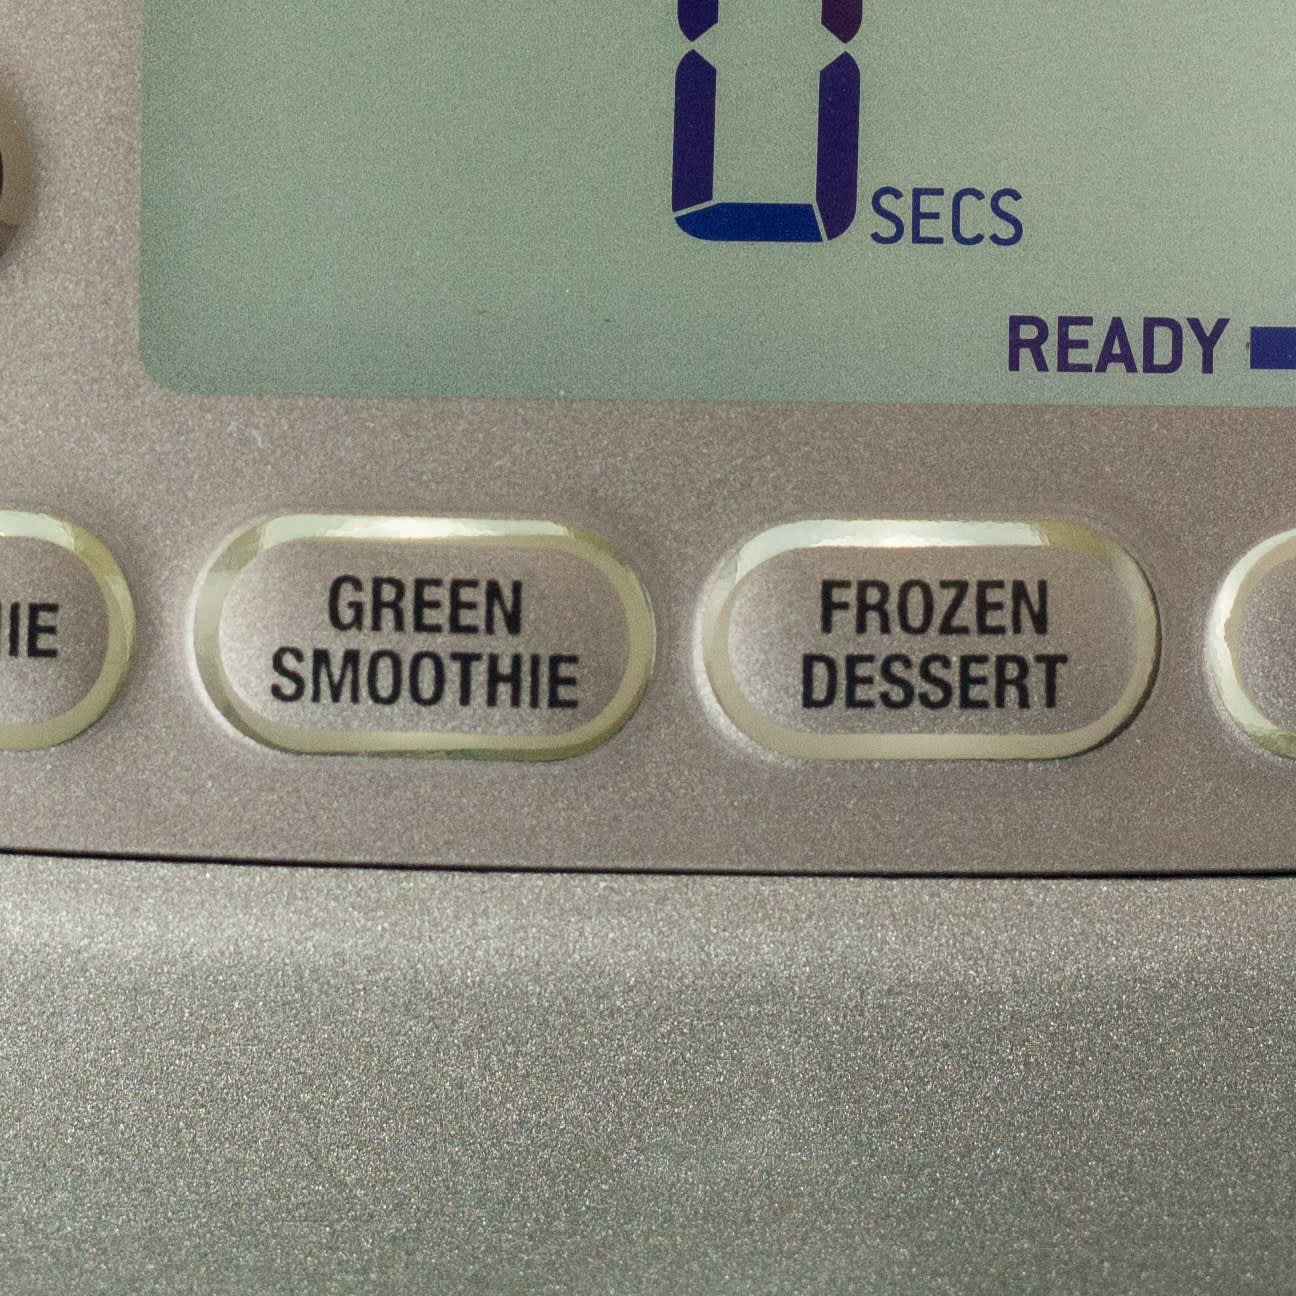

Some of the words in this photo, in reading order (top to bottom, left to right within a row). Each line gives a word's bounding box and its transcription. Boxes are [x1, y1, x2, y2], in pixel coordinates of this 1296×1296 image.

[870, 186, 1025, 248] SECS
[1007, 314, 1230, 375] READY
[326, 573, 523, 636] GREEN
[819, 577, 1050, 637] FROZEN
[269, 645, 579, 709] SMOOTHIE
[800, 652, 1068, 710] DESSERT
